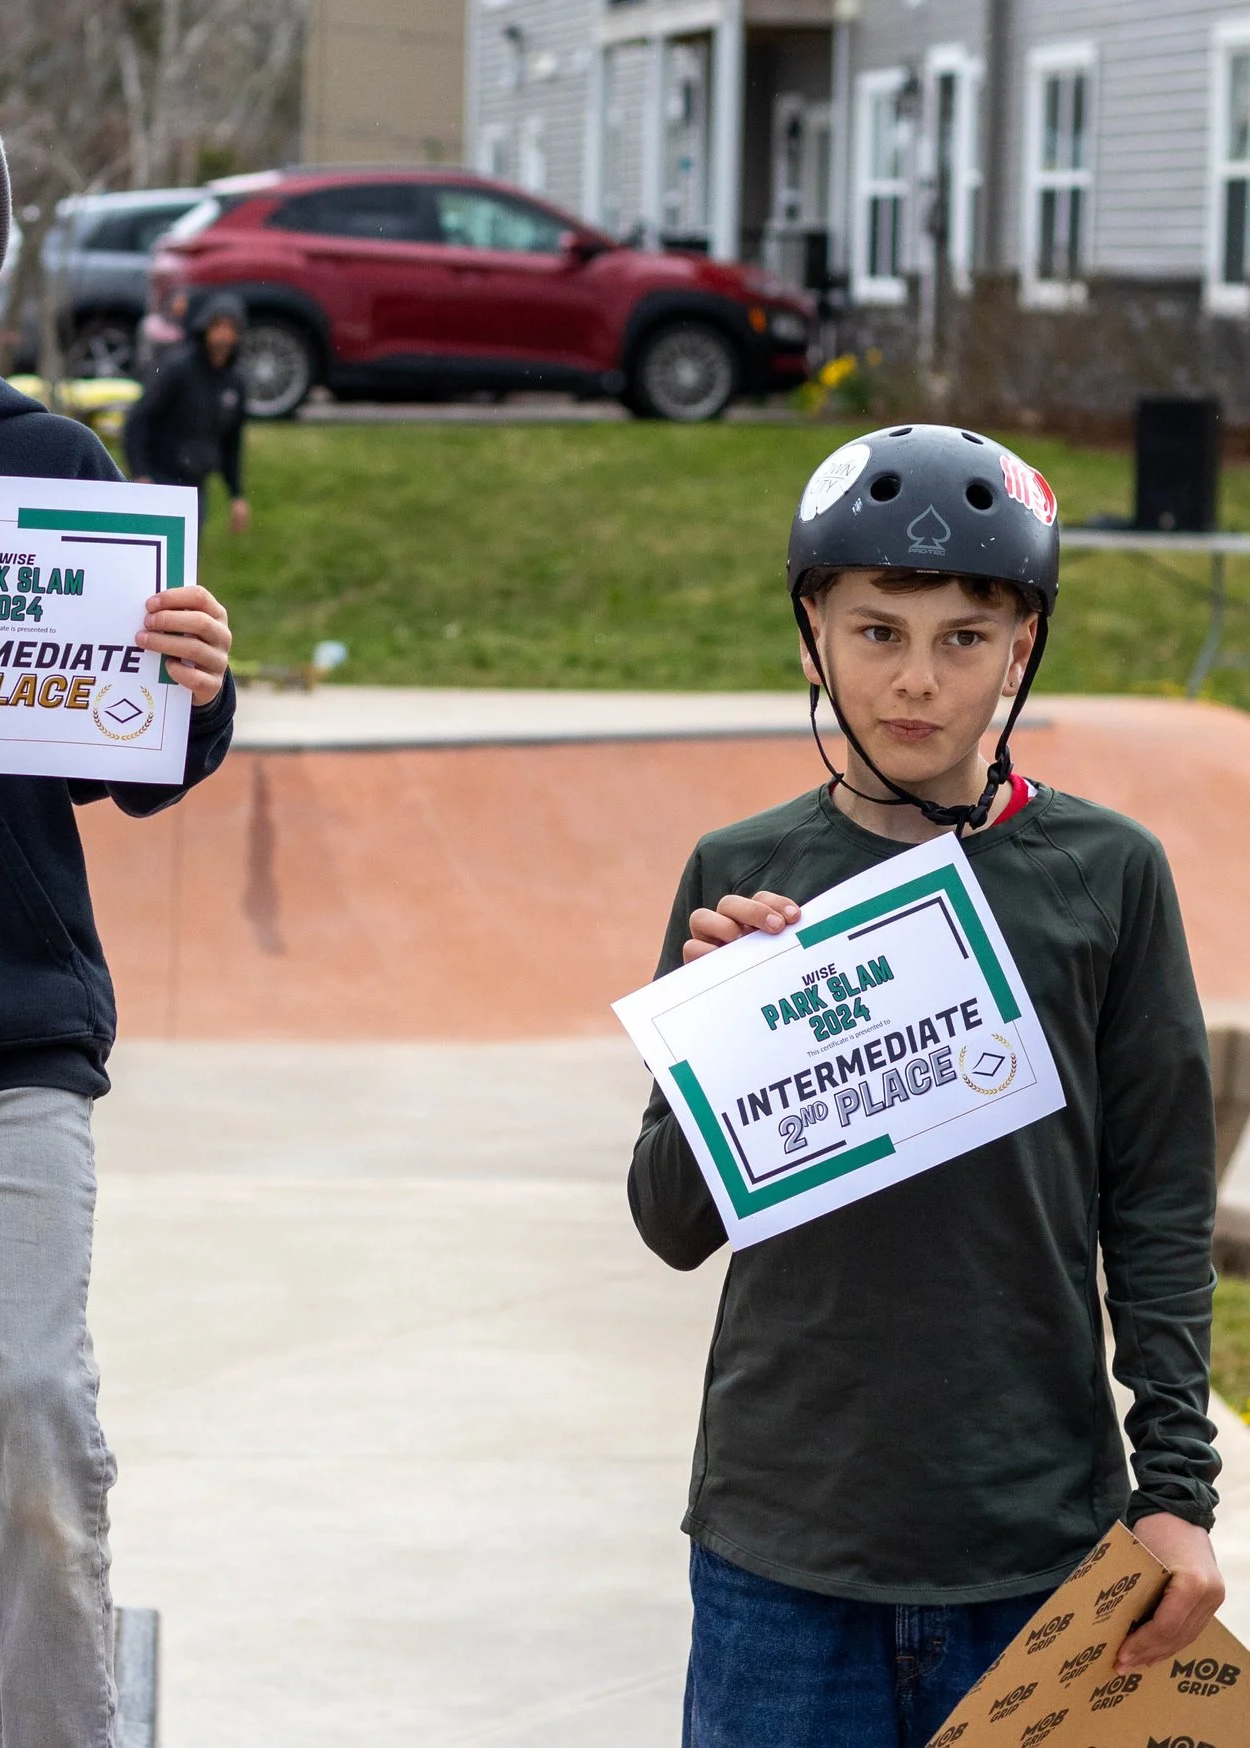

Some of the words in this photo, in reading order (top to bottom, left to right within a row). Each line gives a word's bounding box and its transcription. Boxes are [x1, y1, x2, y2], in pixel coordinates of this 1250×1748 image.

[0, 553, 36, 565] WISE
[17, 566, 85, 595] SLAM
[17, 626, 48, 634] presented
[802, 963, 837, 986] WISE
[761, 984, 828, 1030] PARK
[826, 955, 894, 1002] SLAM
[809, 997, 871, 1042] 2024
[807, 1049, 820, 1058] This
[820, 1037, 849, 1052] certificate
[855, 1022, 883, 1038] presented
[737, 997, 983, 1126] INTERMEDIATE
[834, 1045, 957, 1127] PLACE
[1066, 1564, 1092, 1583] RIP
[1094, 1572, 1142, 1606] MOB
[1096, 1594, 1124, 1615] GRIP
[1025, 1612, 1074, 1647] MOB
[1027, 1634, 1056, 1655] GRIP
[1058, 1643, 1107, 1676] MOB
[1060, 1663, 1089, 1683] GRIP
[1171, 1658, 1241, 1686] MOB
[989, 1682, 1039, 1715] MOB
[1089, 1673, 1142, 1703] MOB
[1091, 1694, 1124, 1711] GRIP
[1177, 1680, 1220, 1697] GRIP
[1020, 1708, 1069, 1741] MOB
